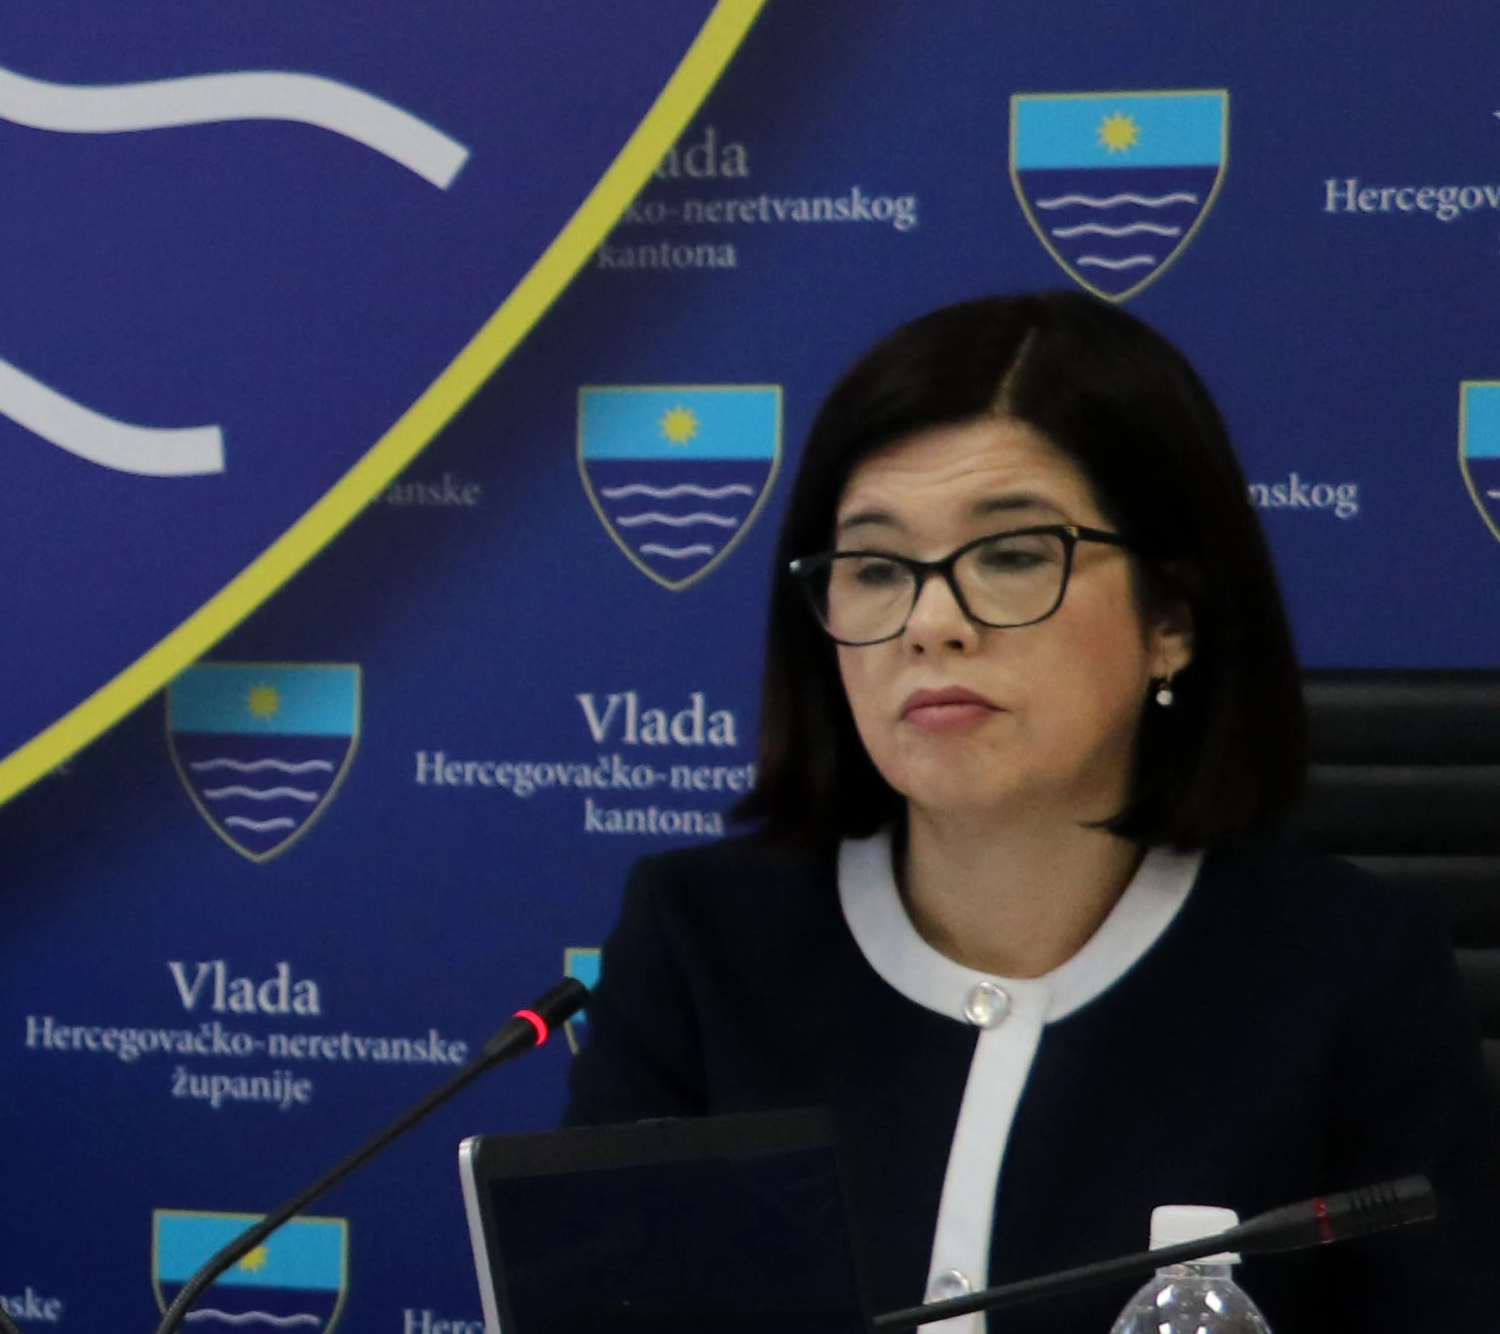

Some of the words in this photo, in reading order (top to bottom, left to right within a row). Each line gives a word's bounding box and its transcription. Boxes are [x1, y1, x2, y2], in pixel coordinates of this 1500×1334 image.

[654, 125, 750, 179] ada
[624, 185, 918, 232] ko-neretvanskog
[575, 690, 738, 747] Vlada
[415, 750, 756, 798] Hercegovačko-neret
[583, 795, 724, 837] kantona
[168, 959, 322, 1017] Vlada
[25, 1014, 469, 1066] Hercegovačko-neretvanske
[171, 1064, 314, 1109] županije
